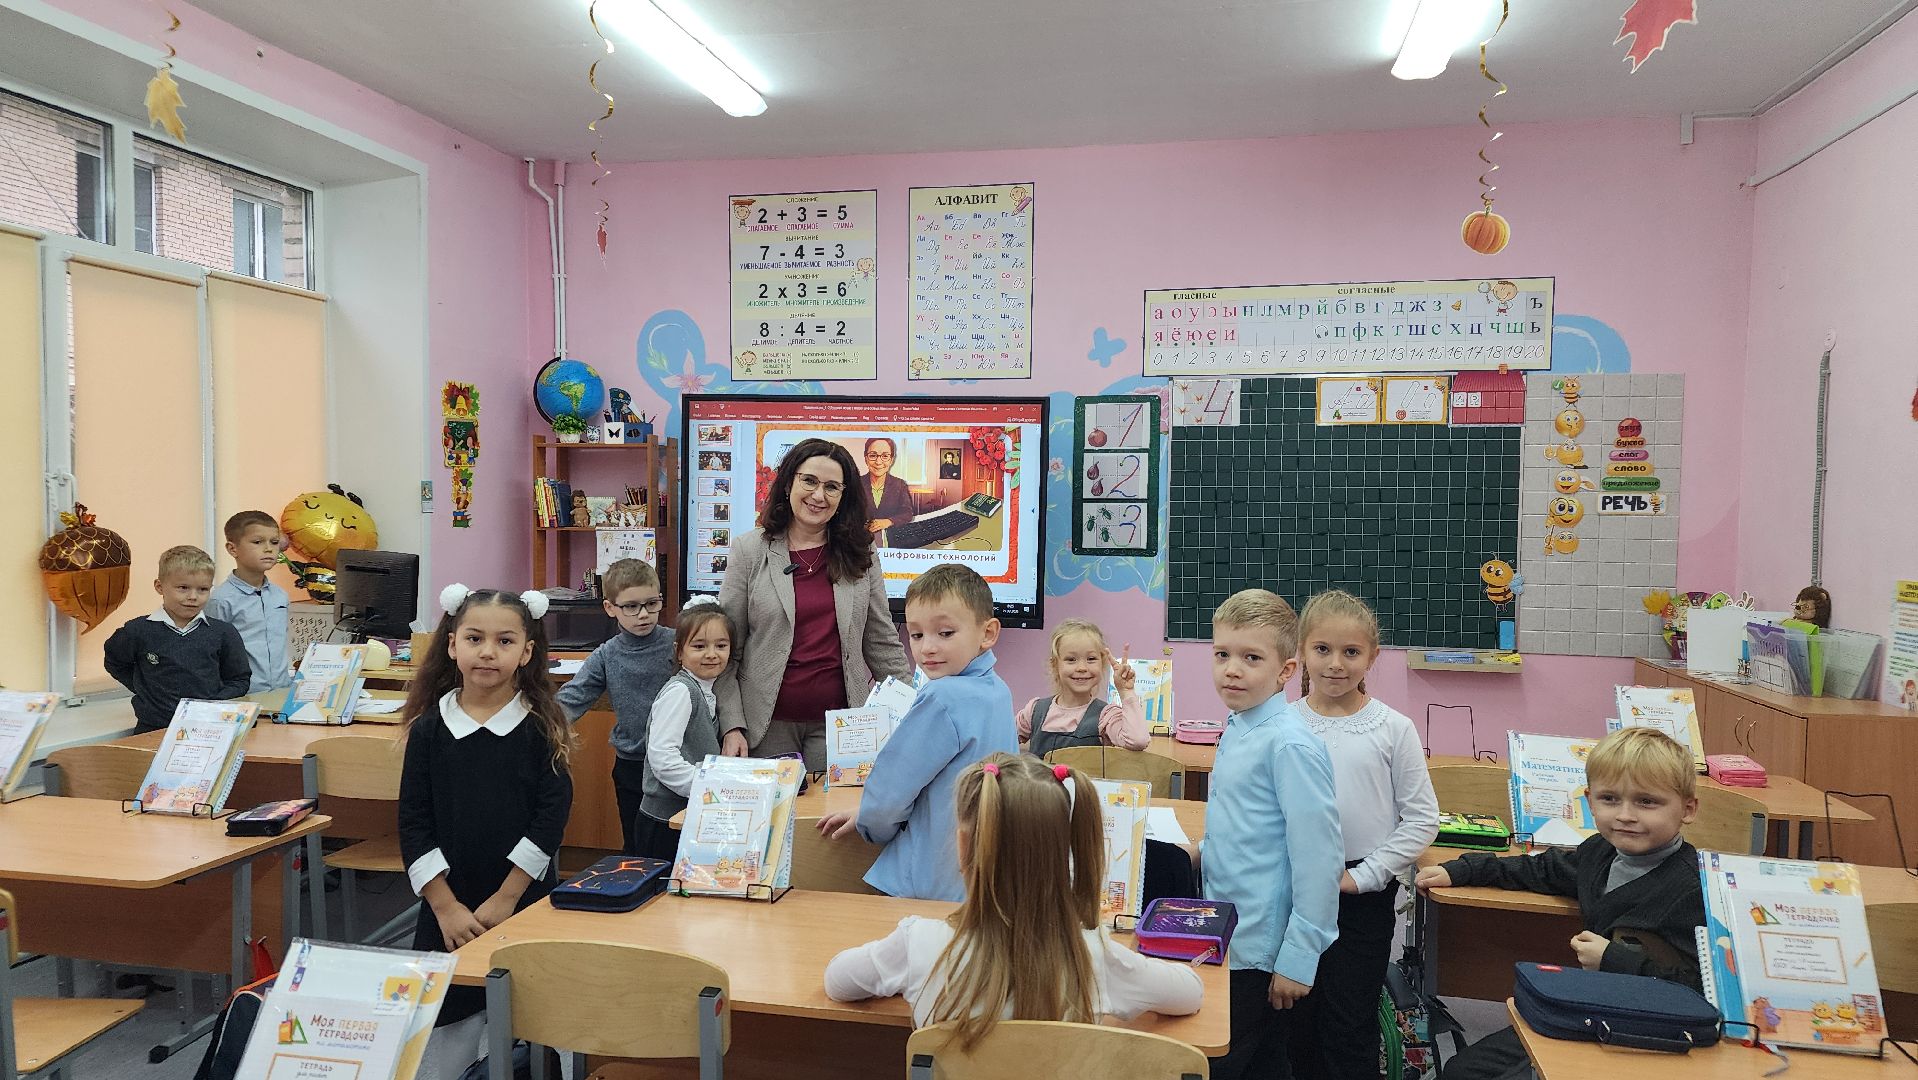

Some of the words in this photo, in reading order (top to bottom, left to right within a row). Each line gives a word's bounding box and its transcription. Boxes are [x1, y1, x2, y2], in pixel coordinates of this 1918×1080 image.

[935, 194, 998, 205] АЛФАВИТ
[758, 208, 768, 223] 2
[797, 207, 806, 222] 3
[837, 205, 847, 221] 5
[760, 246, 770, 260] 7
[795, 245, 805, 259] 4
[835, 243, 844, 258] 3
[759, 283, 768, 298] 2
[797, 283, 807, 298] 3
[837, 282, 847, 297] 6
[1173, 292, 1216, 300] гласные
[1338, 286, 1396, 295] согласные
[1154, 308, 1163, 320] а
[1171, 307, 1182, 318] о
[1189, 307, 1200, 322] у
[1223, 305, 1236, 317] ы
[1261, 305, 1273, 316] л
[1278, 305, 1291, 316] м
[1299, 304, 1310, 319] р
[1317, 299, 1327, 315] й
[1336, 299, 1347, 314] б
[1355, 302, 1365, 313] в
[1392, 302, 1404, 315] д
[1409, 301, 1426, 312] ж
[1433, 300, 1442, 312] з
[1531, 297, 1542, 309] ъ
[760, 322, 769, 337] 8
[795, 322, 805, 336] 4
[836, 321, 846, 336] 2
[1154, 331, 1163, 342] я
[1171, 328, 1181, 341] ё
[1186, 329, 1202, 340] ю
[1207, 329, 1216, 340] е
[1224, 329, 1235, 340] и
[1334, 326, 1346, 337] п
[1352, 322, 1367, 341] ф
[1373, 326, 1384, 336] к
[1394, 325, 1404, 336] т
[1408, 324, 1425, 335] ш
[1431, 323, 1441, 335] с
[1450, 323, 1462, 335] х
[1470, 323, 1482, 336] ц
[1490, 322, 1501, 334] ч
[1530, 322, 1541, 333] ь
[1154, 353, 1163, 365] 0
[1172, 353, 1179, 365] 1
[1189, 352, 1198, 365] 2
[1207, 352, 1216, 364] 3
[1225, 352, 1233, 364] 4
[1242, 351, 1252, 364] 5
[1260, 351, 1271, 363] 6
[1279, 350, 1288, 363] 7
[1298, 350, 1307, 363] 8
[1315, 349, 1326, 362] 9
[1333, 349, 1348, 362] 10
[1351, 349, 1367, 362] 11
[1369, 348, 1385, 361] 12
[1389, 348, 1405, 361] 13
[1409, 347, 1425, 360] 14
[1427, 346, 1445, 360] 15
[1447, 346, 1464, 359] 16
[1467, 346, 1484, 359] 17
[1486, 345, 1503, 359] 18
[1505, 345, 1523, 358] 19
[1525, 345, 1544, 358] 20
[1204, 380, 1234, 424] 4
[1119, 404, 1143, 447] 1
[1106, 455, 1140, 497] 2
[1602, 496, 1648, 511] РЕЧЬ
[1111, 505, 1142, 547] 3
[884, 551, 934, 560] цифровых
